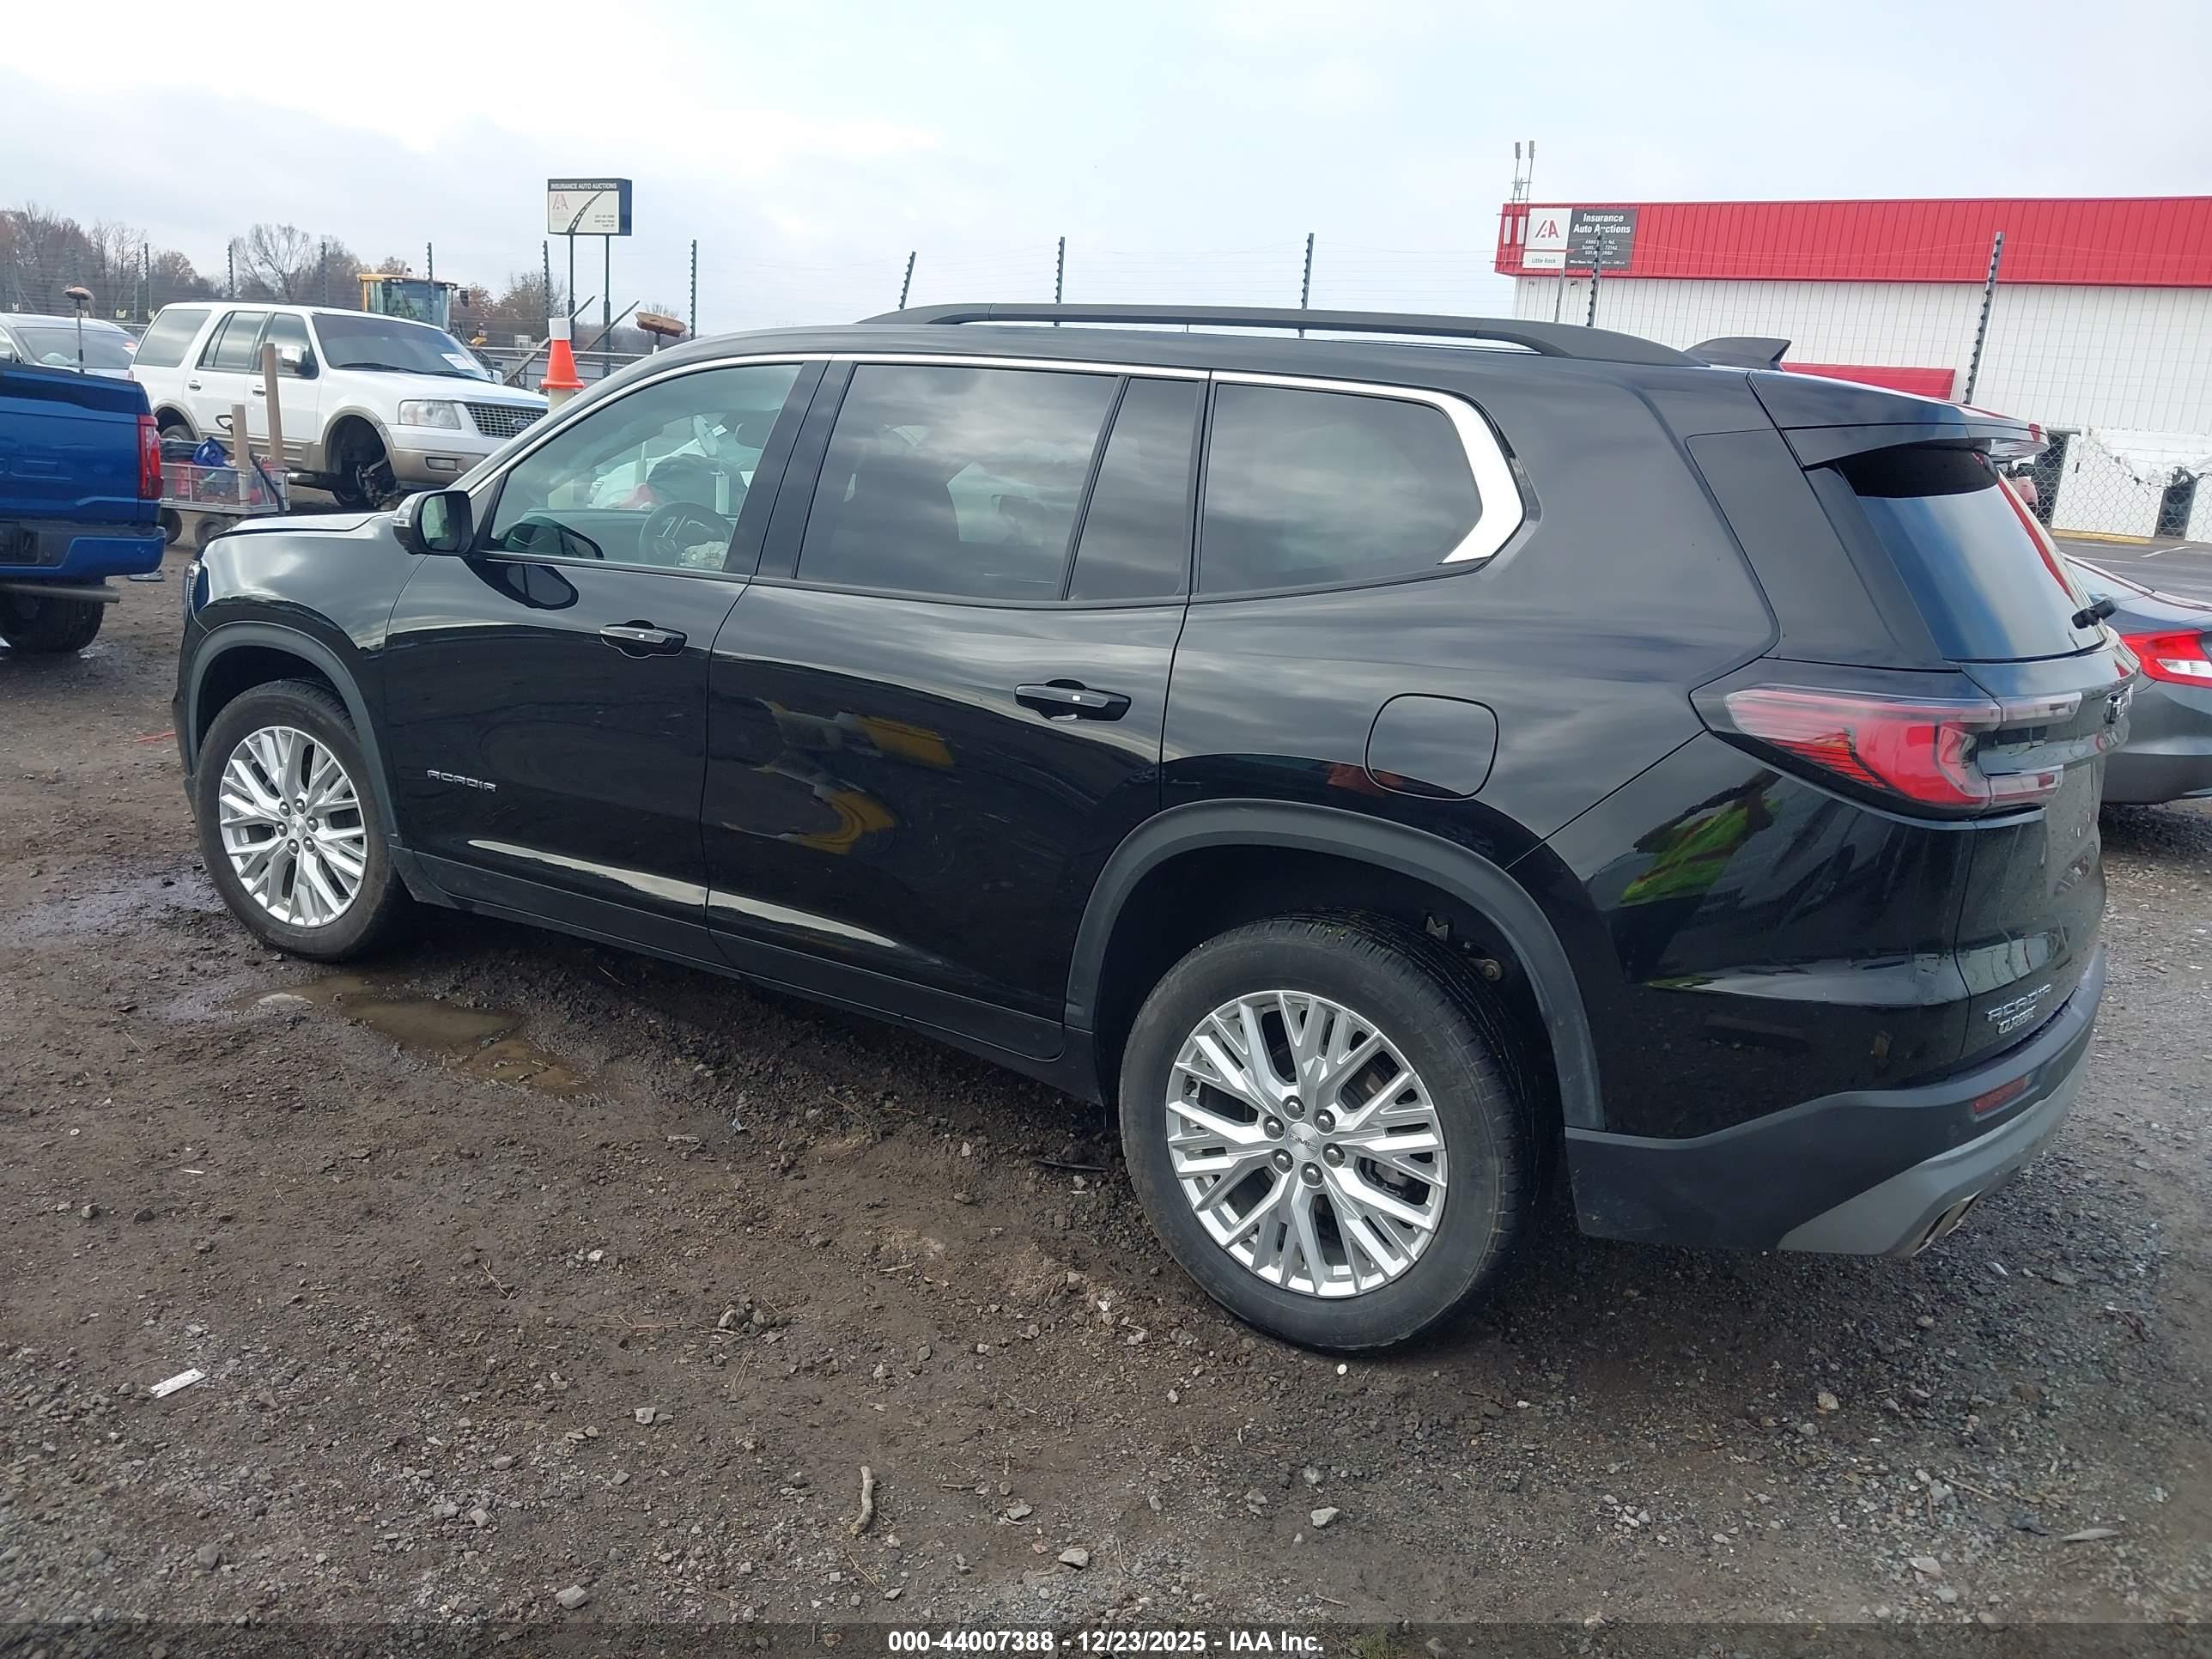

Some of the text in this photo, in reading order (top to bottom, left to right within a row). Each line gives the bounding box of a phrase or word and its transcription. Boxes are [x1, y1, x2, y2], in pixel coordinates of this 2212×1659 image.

[1583, 213, 1625, 222] Insurance
[1573, 223, 1593, 234] Auto
[426, 769, 497, 793] ACADIA
[1985, 983, 2052, 1022] ACADIA
[1288, 1132, 1318, 1152] GMC
